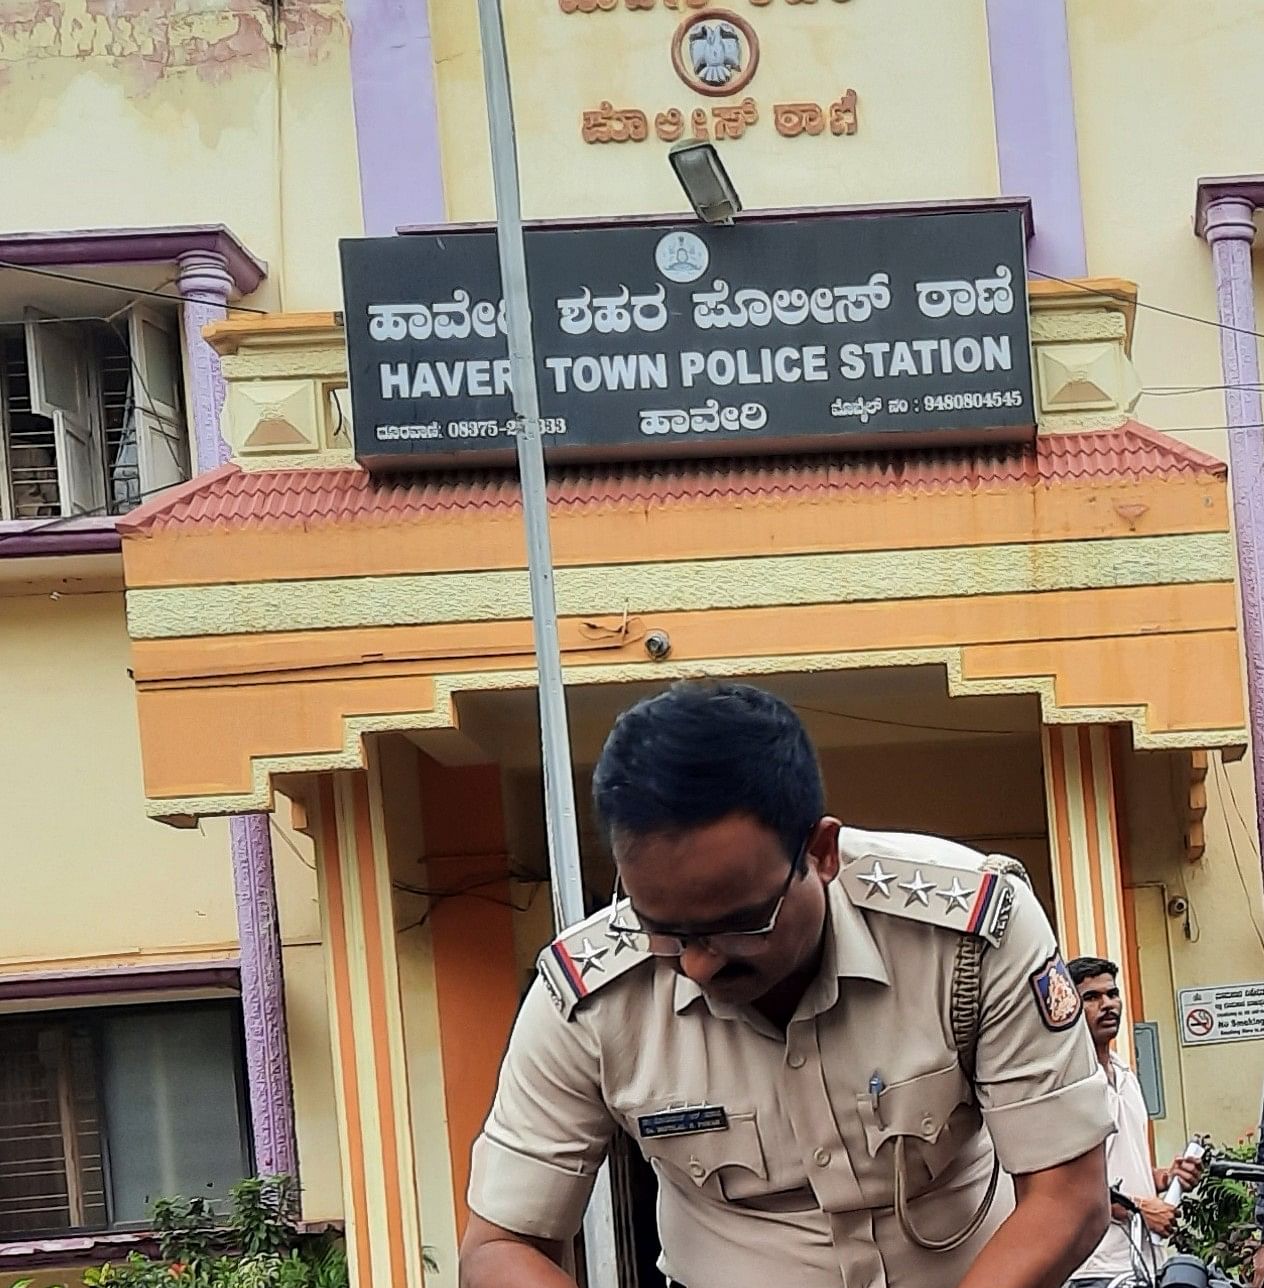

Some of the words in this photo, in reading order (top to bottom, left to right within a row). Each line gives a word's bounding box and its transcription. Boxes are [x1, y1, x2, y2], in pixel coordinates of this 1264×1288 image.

[557, 283, 668, 334] ಶಹರ
[692, 273, 891, 329] ಪೊಲೀಸ್
[915, 264, 1014, 318] ಠಾಣೆ
[380, 360, 514, 398] HAVER
[545, 353, 668, 393] TOWN
[680, 345, 829, 387] POLICE
[840, 335, 1012, 380] STATION
[639, 399, 768, 435] ಹಾವೇರಿ
